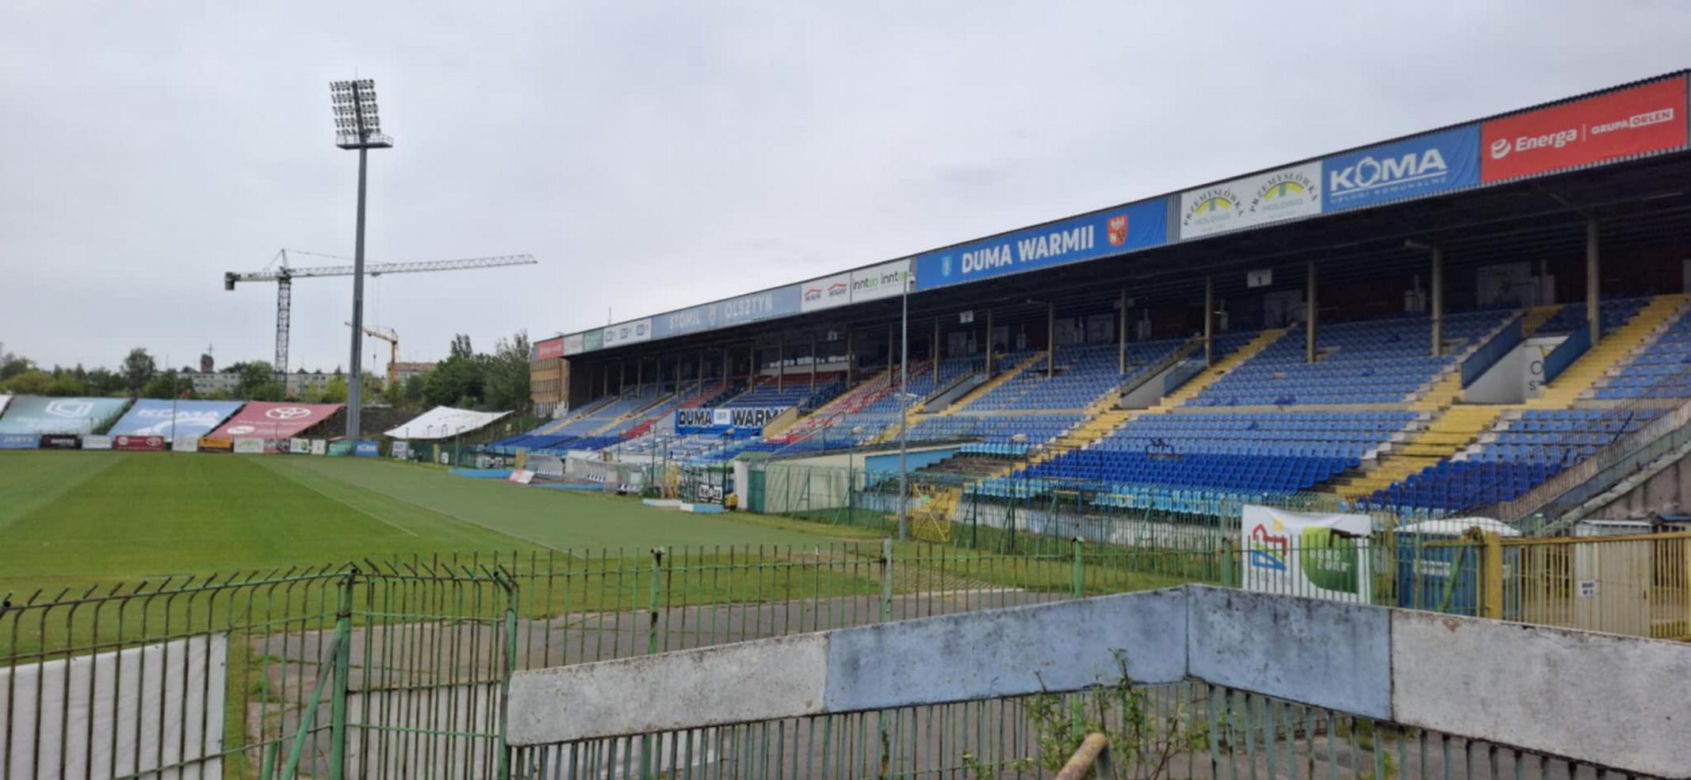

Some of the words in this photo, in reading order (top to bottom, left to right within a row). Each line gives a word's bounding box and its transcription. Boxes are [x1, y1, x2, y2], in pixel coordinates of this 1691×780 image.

[1591, 120, 1631, 135] GRUPA
[1631, 110, 1672, 127] ORLEN
[1515, 129, 1577, 148] Energa
[1330, 148, 1448, 192] KOMA
[962, 244, 1013, 274] DUMA
[1018, 225, 1094, 262] WARMII
[669, 310, 701, 330] STOMIL
[725, 293, 773, 319] OLSZTYN
[679, 408, 712, 425] DUMA
